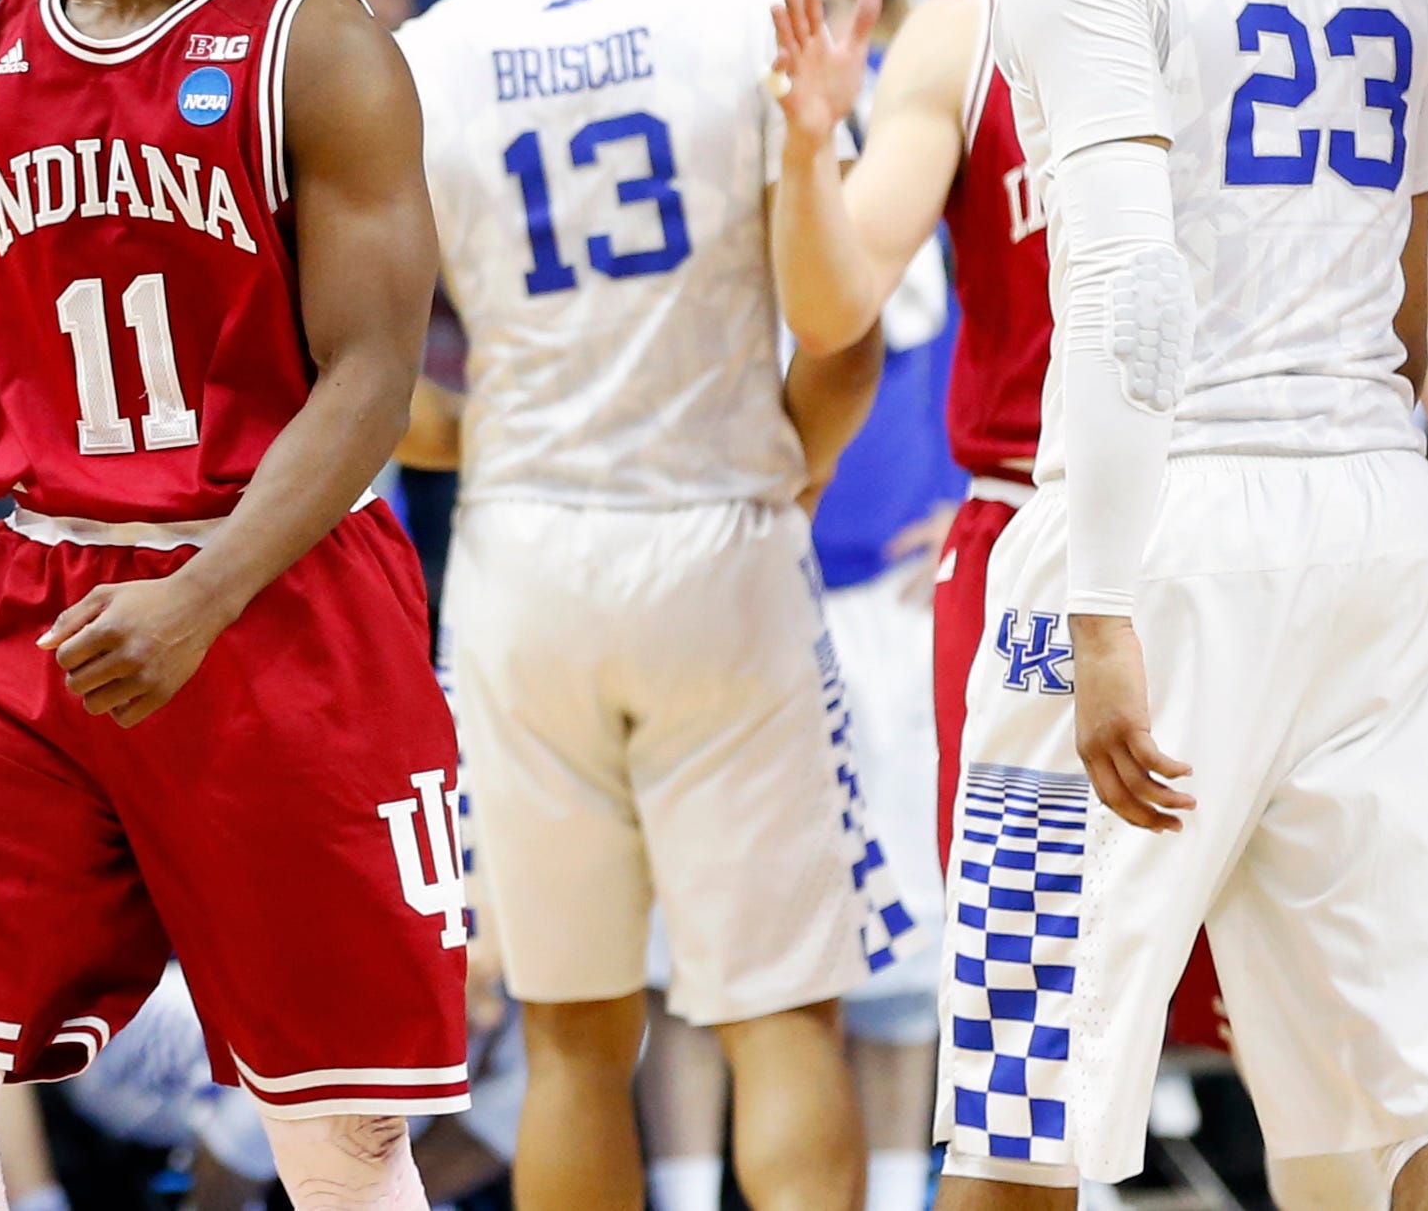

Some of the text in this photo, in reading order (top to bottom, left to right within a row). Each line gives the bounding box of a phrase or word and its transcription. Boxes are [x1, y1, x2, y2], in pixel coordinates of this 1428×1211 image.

[183, 93, 230, 112] NCAA
[492, 27, 654, 102] BRISCOE
[1221, 2, 1413, 192] 23
[503, 111, 693, 296] 13
[55, 272, 200, 456] 11
[994, 608, 1074, 695] UK
